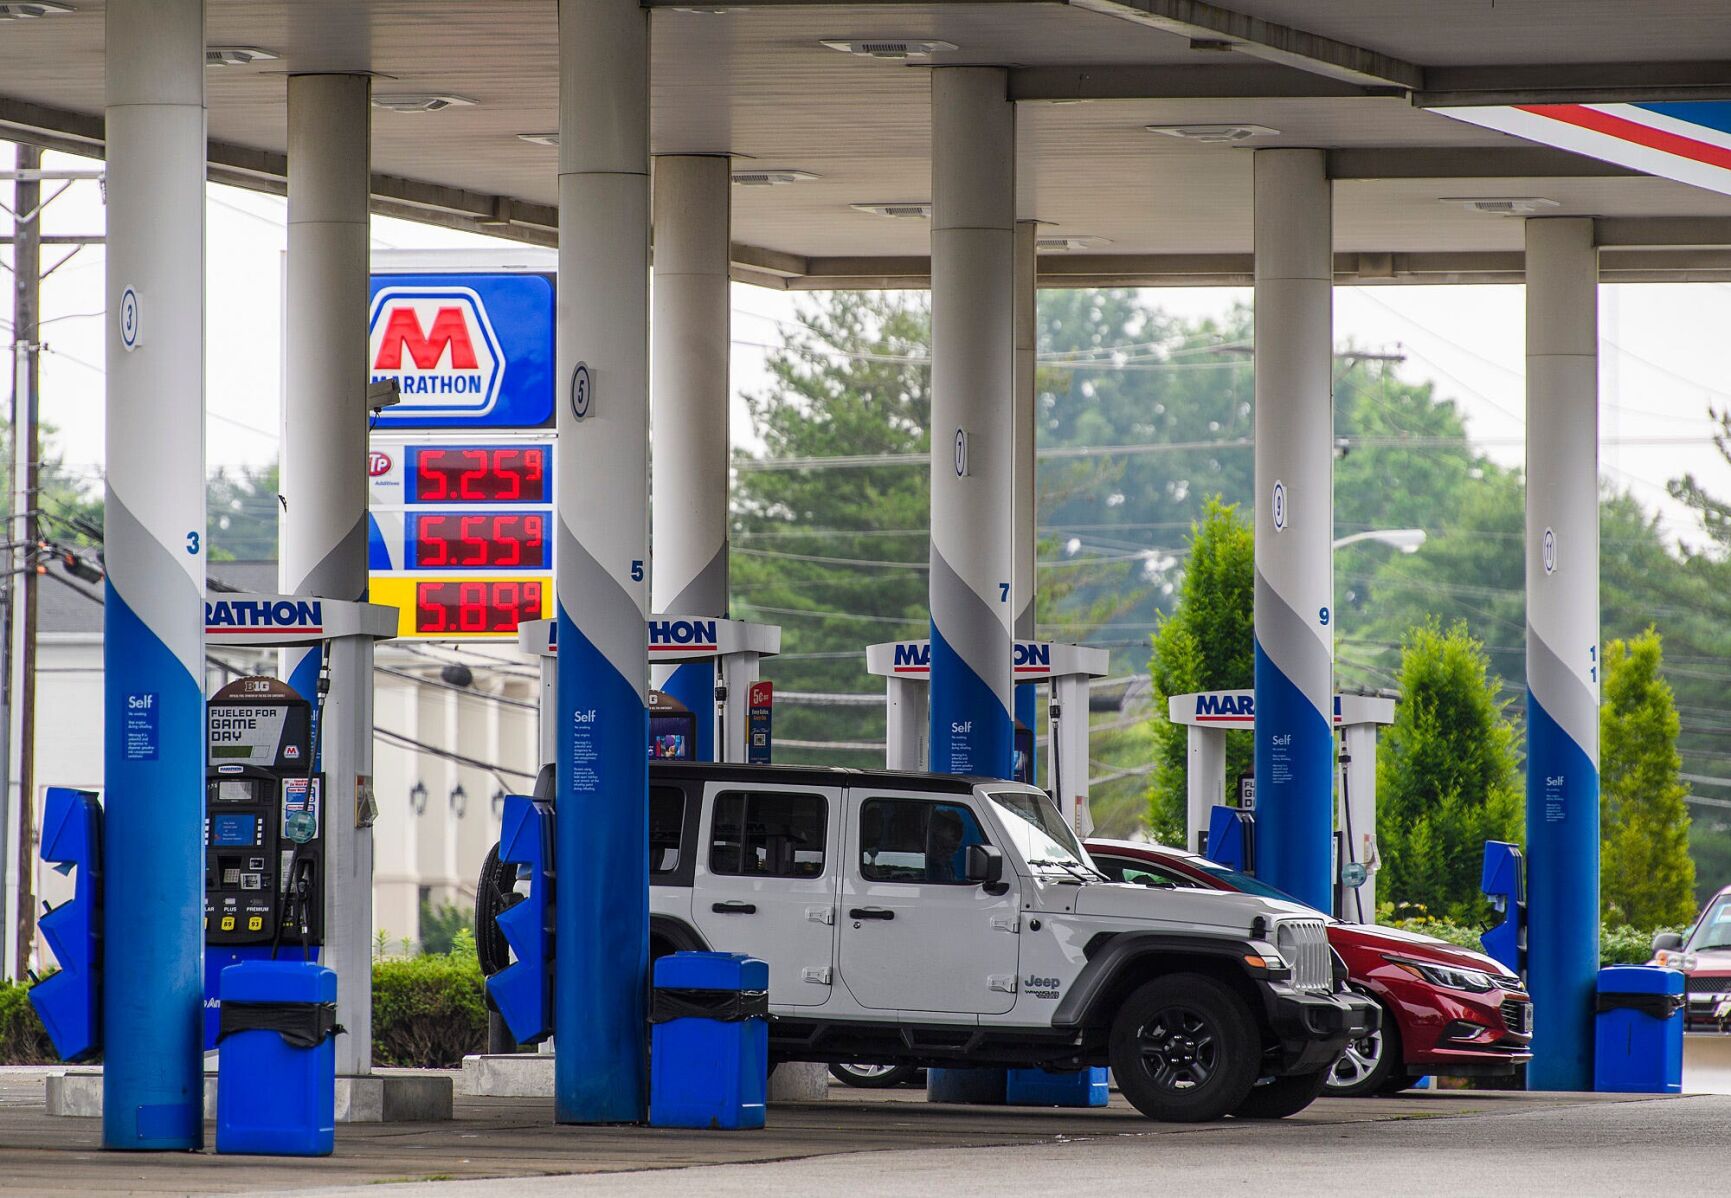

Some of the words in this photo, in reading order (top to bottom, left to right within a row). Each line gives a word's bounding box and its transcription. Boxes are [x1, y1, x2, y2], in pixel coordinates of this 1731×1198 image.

[126, 303, 134, 331] 3
[373, 307, 479, 370] M
[371, 376, 482, 394] RATHON
[577, 379, 585, 404] 5
[186, 531, 200, 555] 3
[631, 560, 644, 582] 5
[999, 582, 1011, 603] 7
[1319, 607, 1330, 625] 9
[128, 694, 153, 709] Self
[211, 709, 253, 718] FUELED
[255, 709, 277, 718] FOR
[574, 709, 597, 723] Self
[211, 719, 257, 730] GAME
[951, 721, 973, 733] Self
[211, 731, 242, 742] DAY
[1272, 734, 1292, 746] Self
[1546, 775, 1565, 786] Self
[1024, 974, 1061, 990] Jeep
